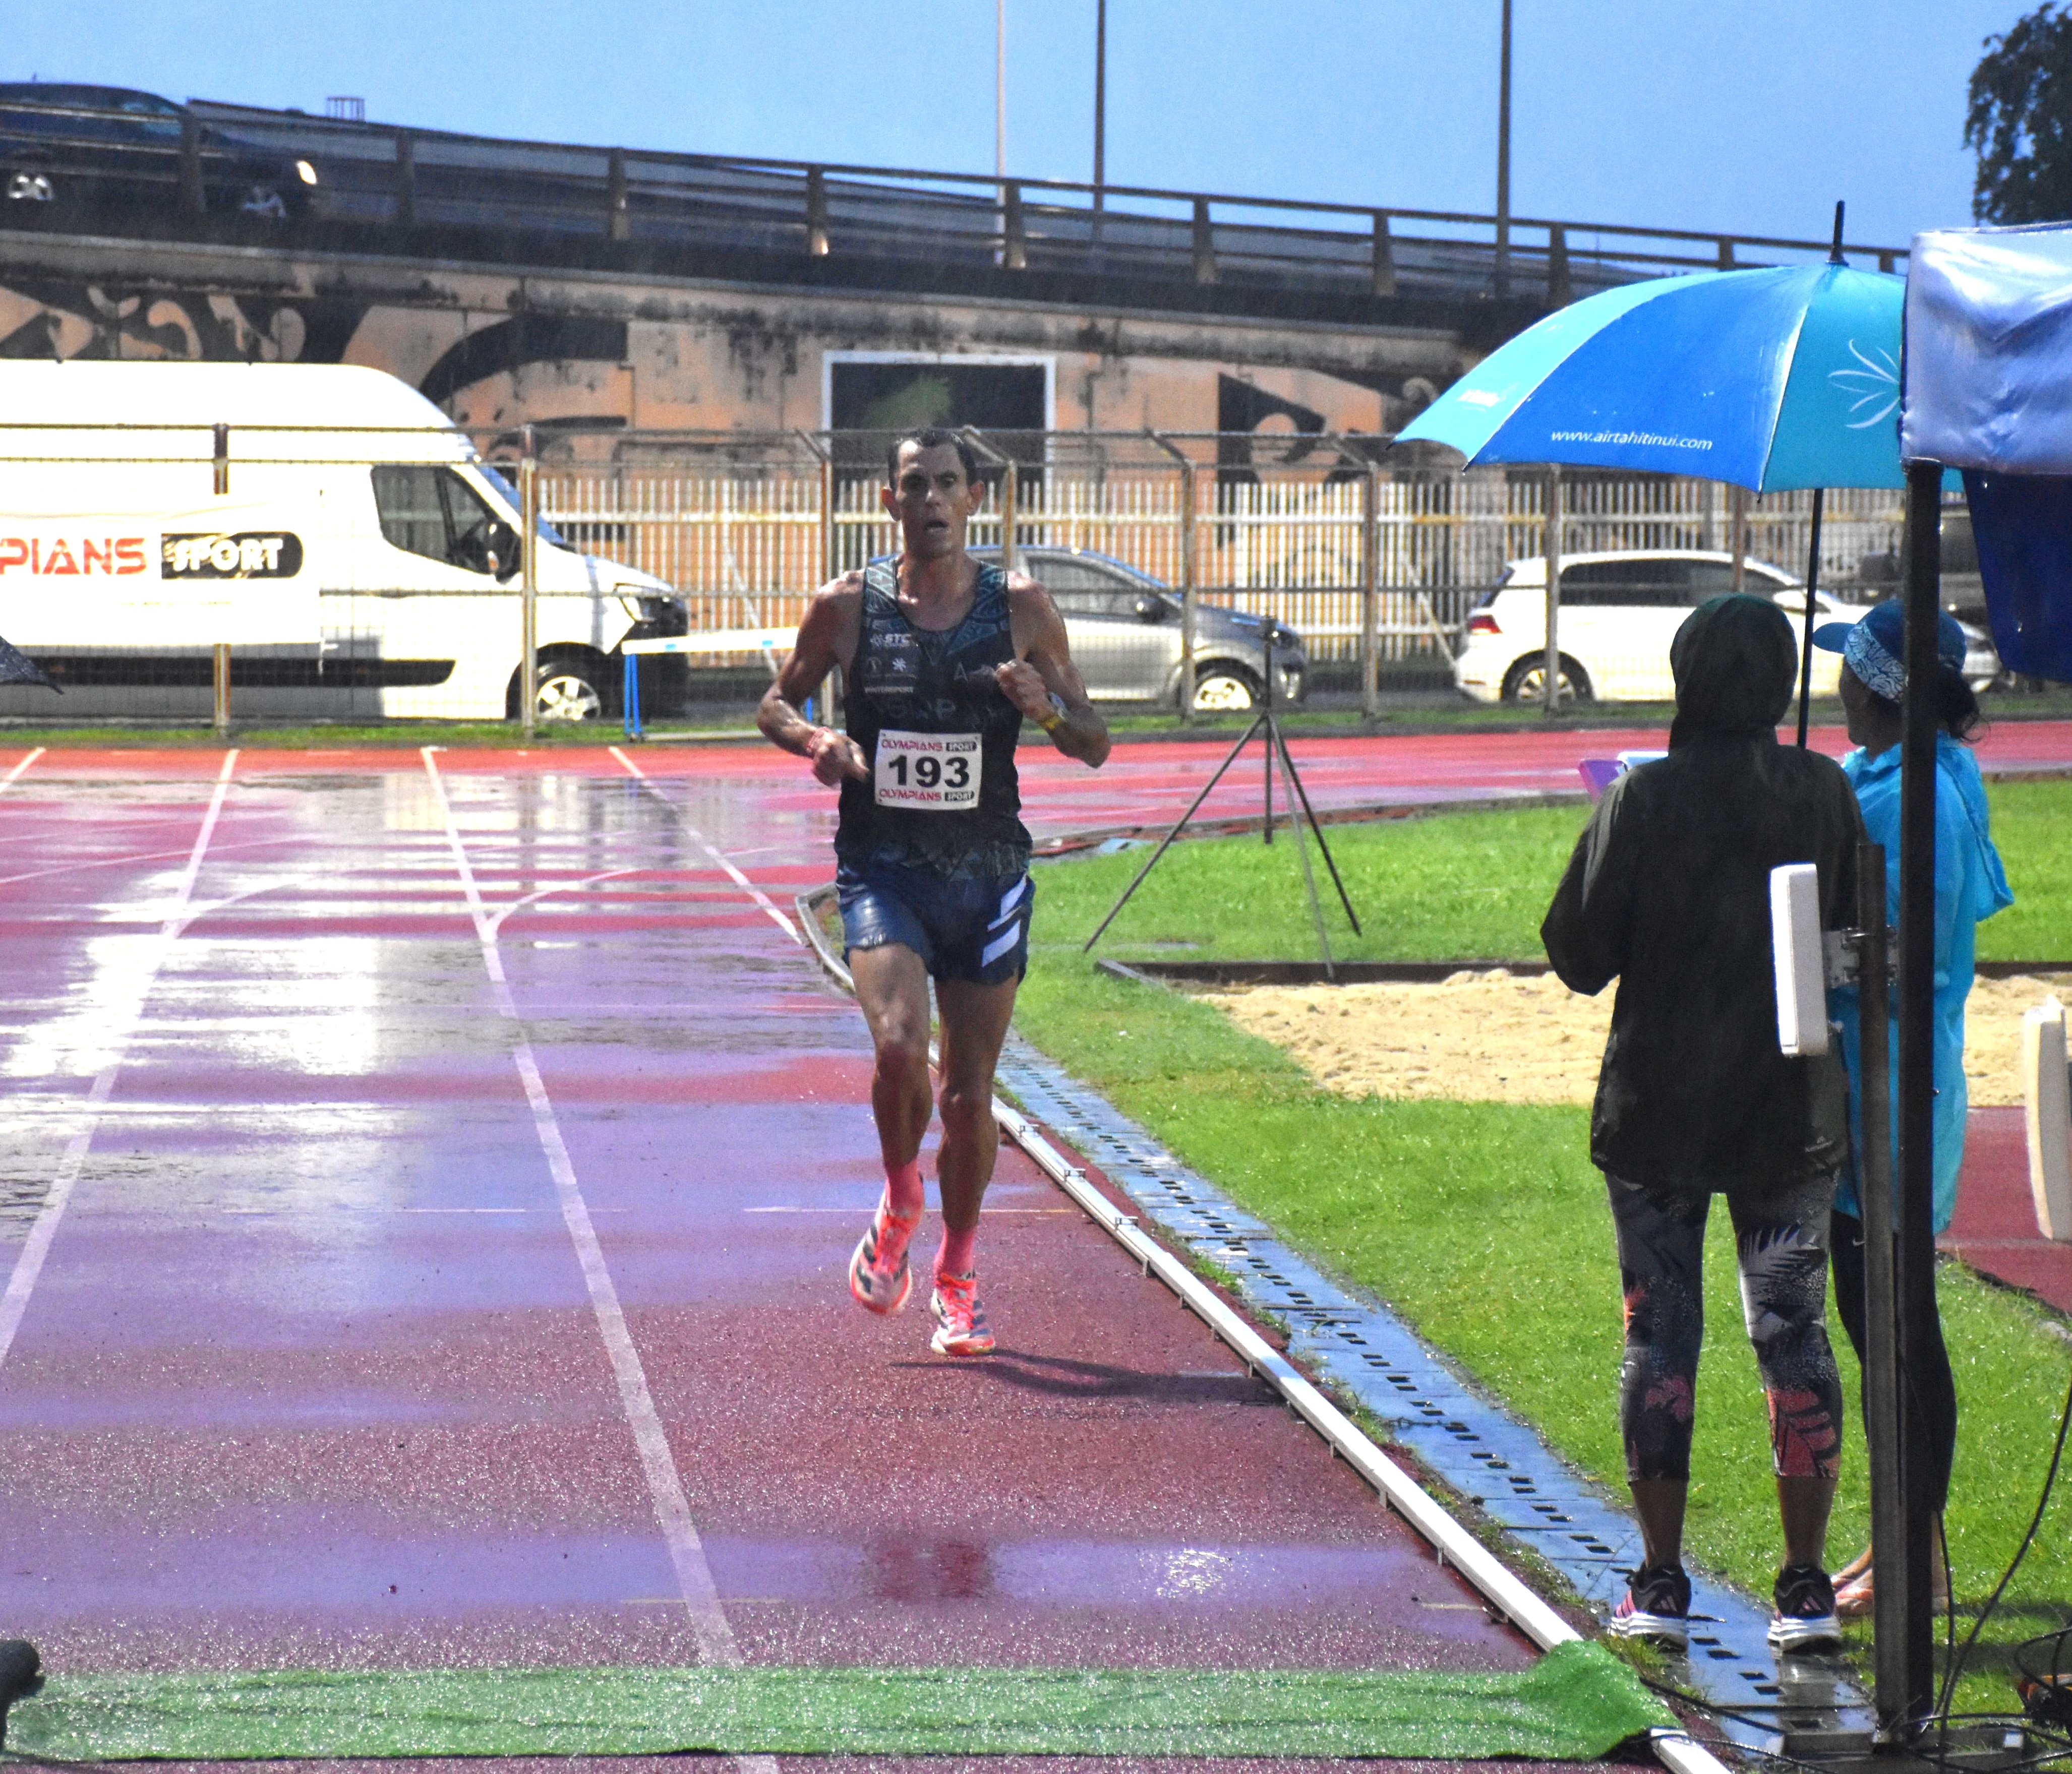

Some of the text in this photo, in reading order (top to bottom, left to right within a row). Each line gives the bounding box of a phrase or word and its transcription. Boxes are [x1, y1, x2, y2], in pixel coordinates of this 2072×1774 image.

[1551, 430, 1713, 451] www.airtahitinui.com
[881, 739, 943, 752] OLYMPIANS
[888, 755, 970, 788] 193
[879, 788, 942, 802] OLYMPIANS
